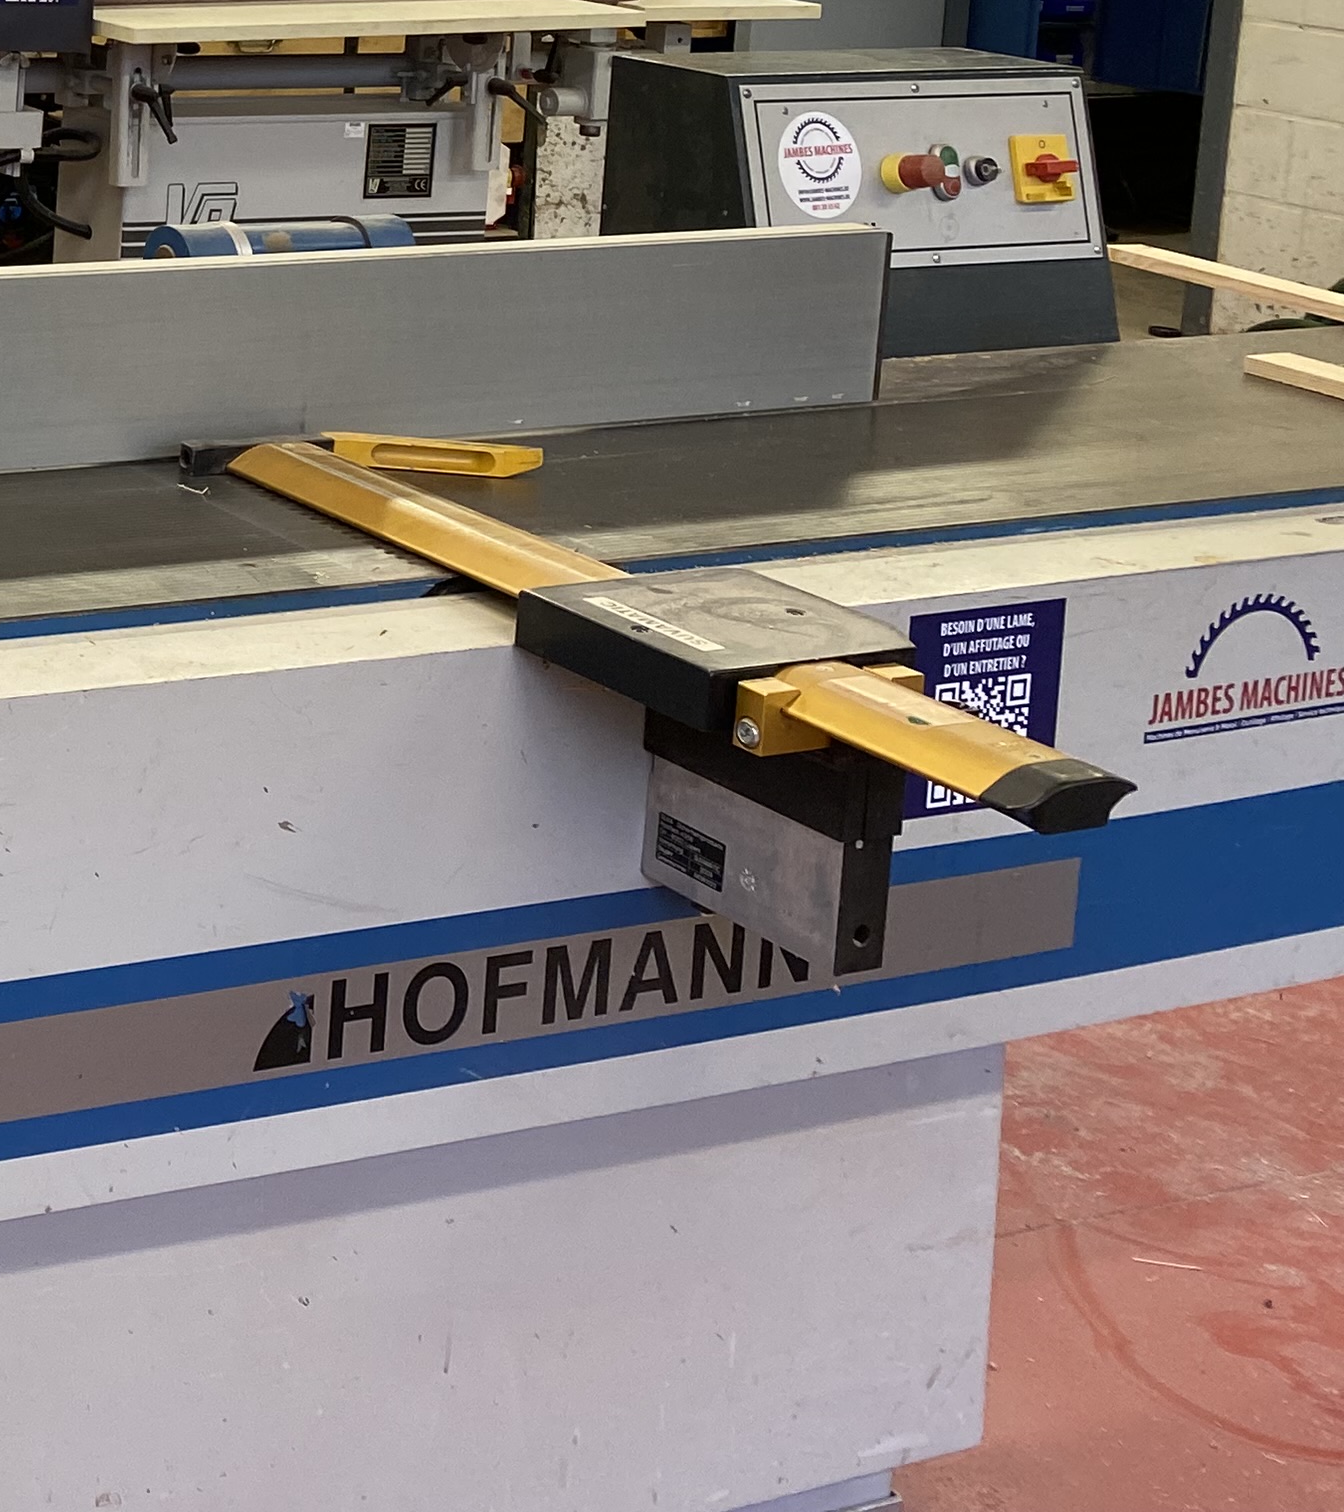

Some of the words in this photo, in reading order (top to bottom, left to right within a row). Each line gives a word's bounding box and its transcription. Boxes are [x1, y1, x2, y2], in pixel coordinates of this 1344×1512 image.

[784, 146, 813, 158] JAMBES
[814, 143, 853, 156] MACHINES
[940, 619, 975, 636] BESOIN
[976, 616, 1006, 632] D'UNE
[1007, 613, 1035, 628] LAME,
[943, 641, 969, 657] D'UN
[969, 635, 1015, 654] AFFUTAGE
[1016, 634, 1030, 648] OU
[943, 662, 969, 678] D'UN
[969, 656, 1020, 675] ENTRETIEN
[1021, 655, 1027, 669] ?
[1148, 682, 1235, 726] JAMBES
[1240, 667, 1344, 712] MACHINES
